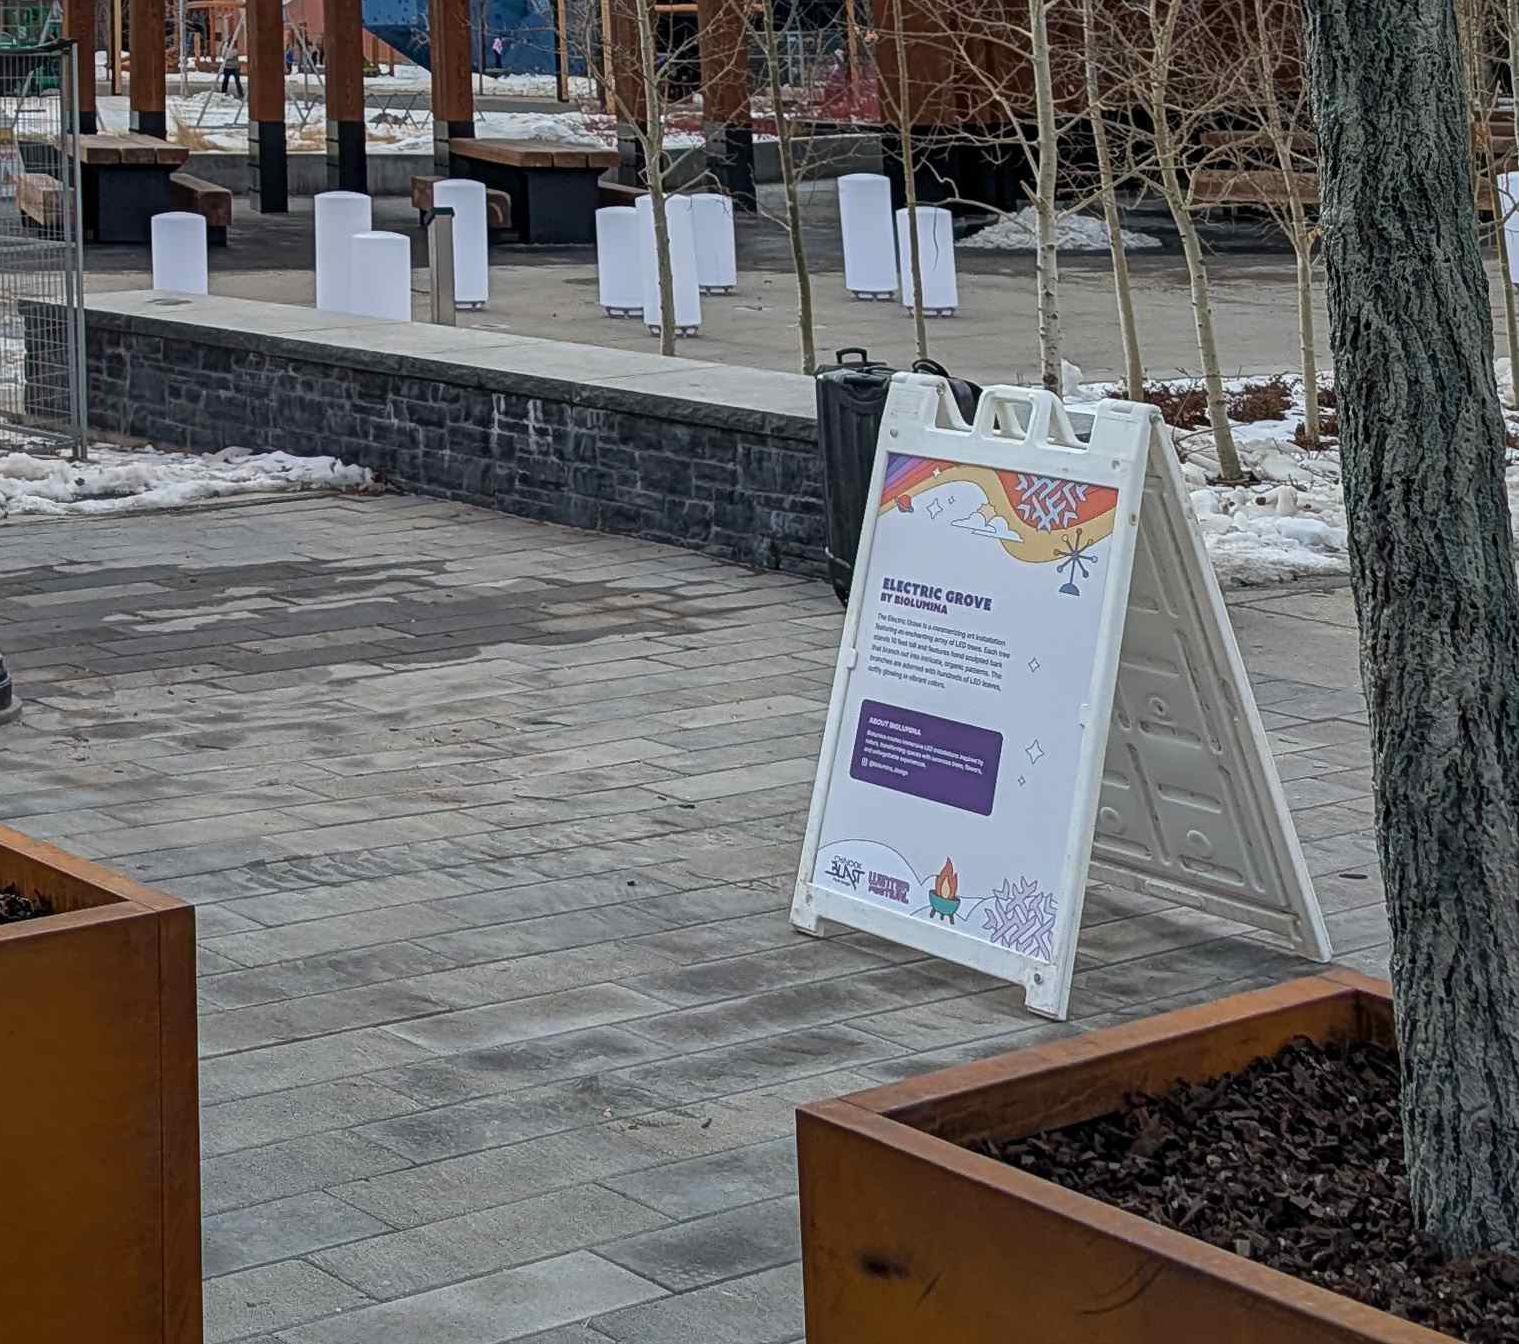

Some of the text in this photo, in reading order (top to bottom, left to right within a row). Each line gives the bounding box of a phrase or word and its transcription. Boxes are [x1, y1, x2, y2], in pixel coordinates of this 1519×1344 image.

[882, 578, 992, 610] ELECTRIC GROVE
[880, 592, 948, 614] BY BIOLUMINA
[955, 640, 966, 649] LED
[983, 646, 998, 655] Each
[969, 676, 981, 686] LED
[868, 716, 889, 728] ABOUT
